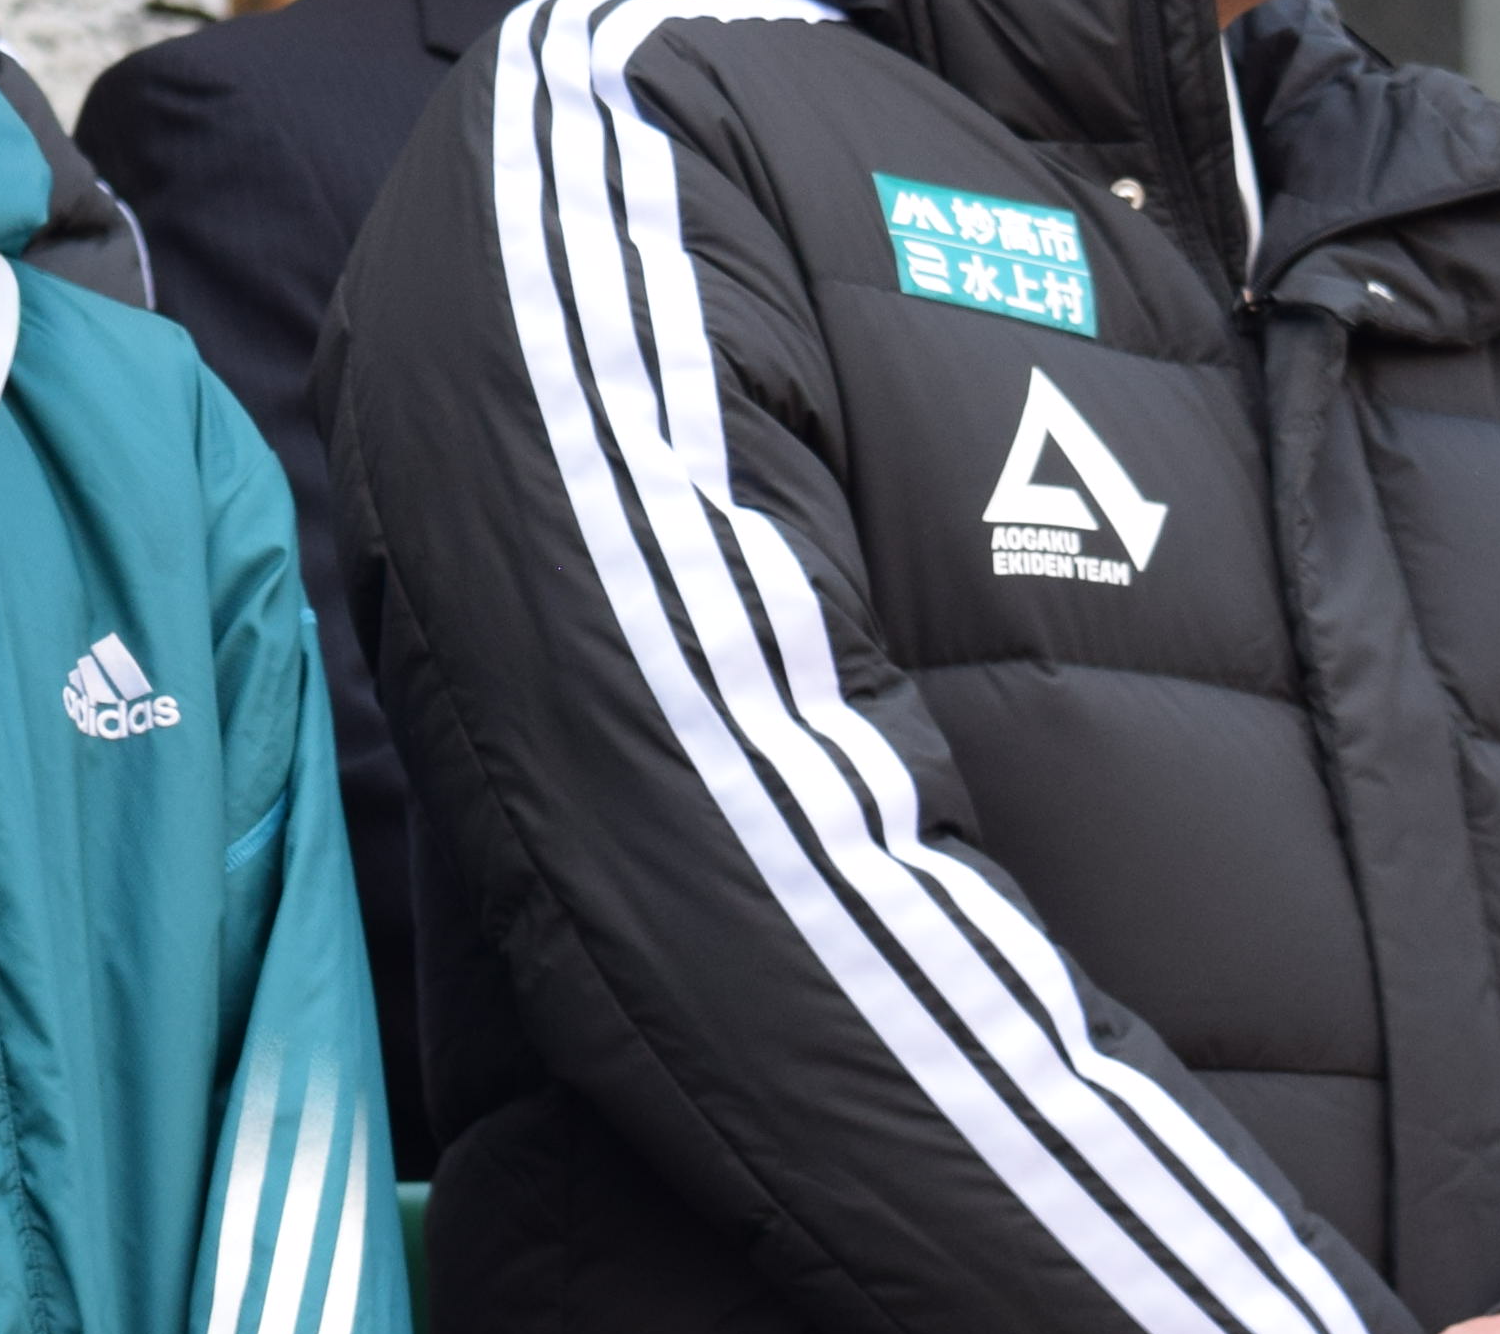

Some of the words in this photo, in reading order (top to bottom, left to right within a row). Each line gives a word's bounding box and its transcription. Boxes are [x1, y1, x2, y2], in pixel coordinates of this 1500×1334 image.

[951, 197, 1079, 264] 妙高市
[960, 255, 1085, 326] 水上村
[991, 525, 1081, 556] AOGAKU
[991, 549, 1075, 580] EKIDEN
[1074, 556, 1131, 587] TEAM
[63, 685, 181, 739] adidas
